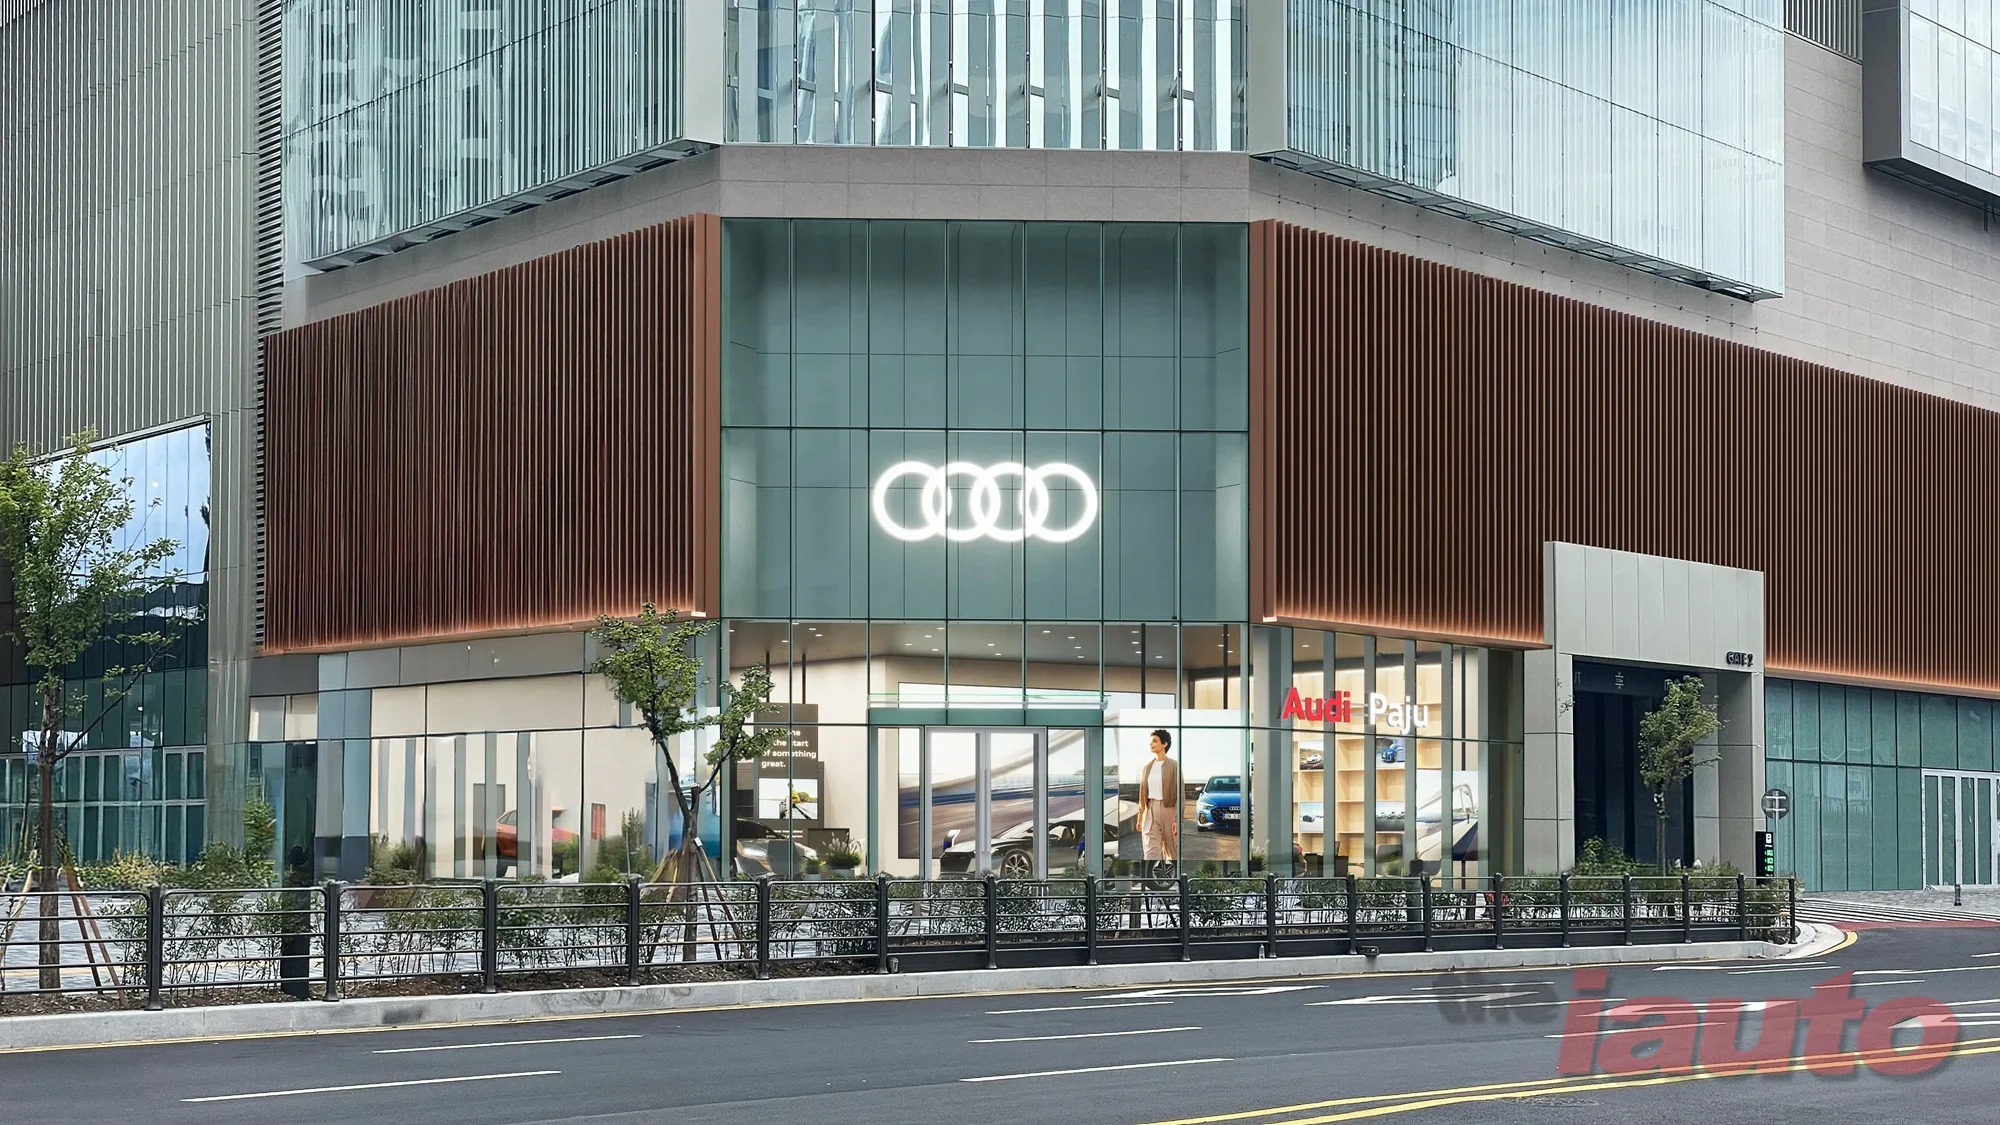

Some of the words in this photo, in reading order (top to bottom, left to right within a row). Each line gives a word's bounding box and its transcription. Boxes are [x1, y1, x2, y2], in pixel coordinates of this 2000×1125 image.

[1726, 651, 1747, 665] GATE
[1747, 653, 1754, 667] 2
[1282, 687, 1351, 723] Audi
[1369, 692, 1429, 735] Paju
